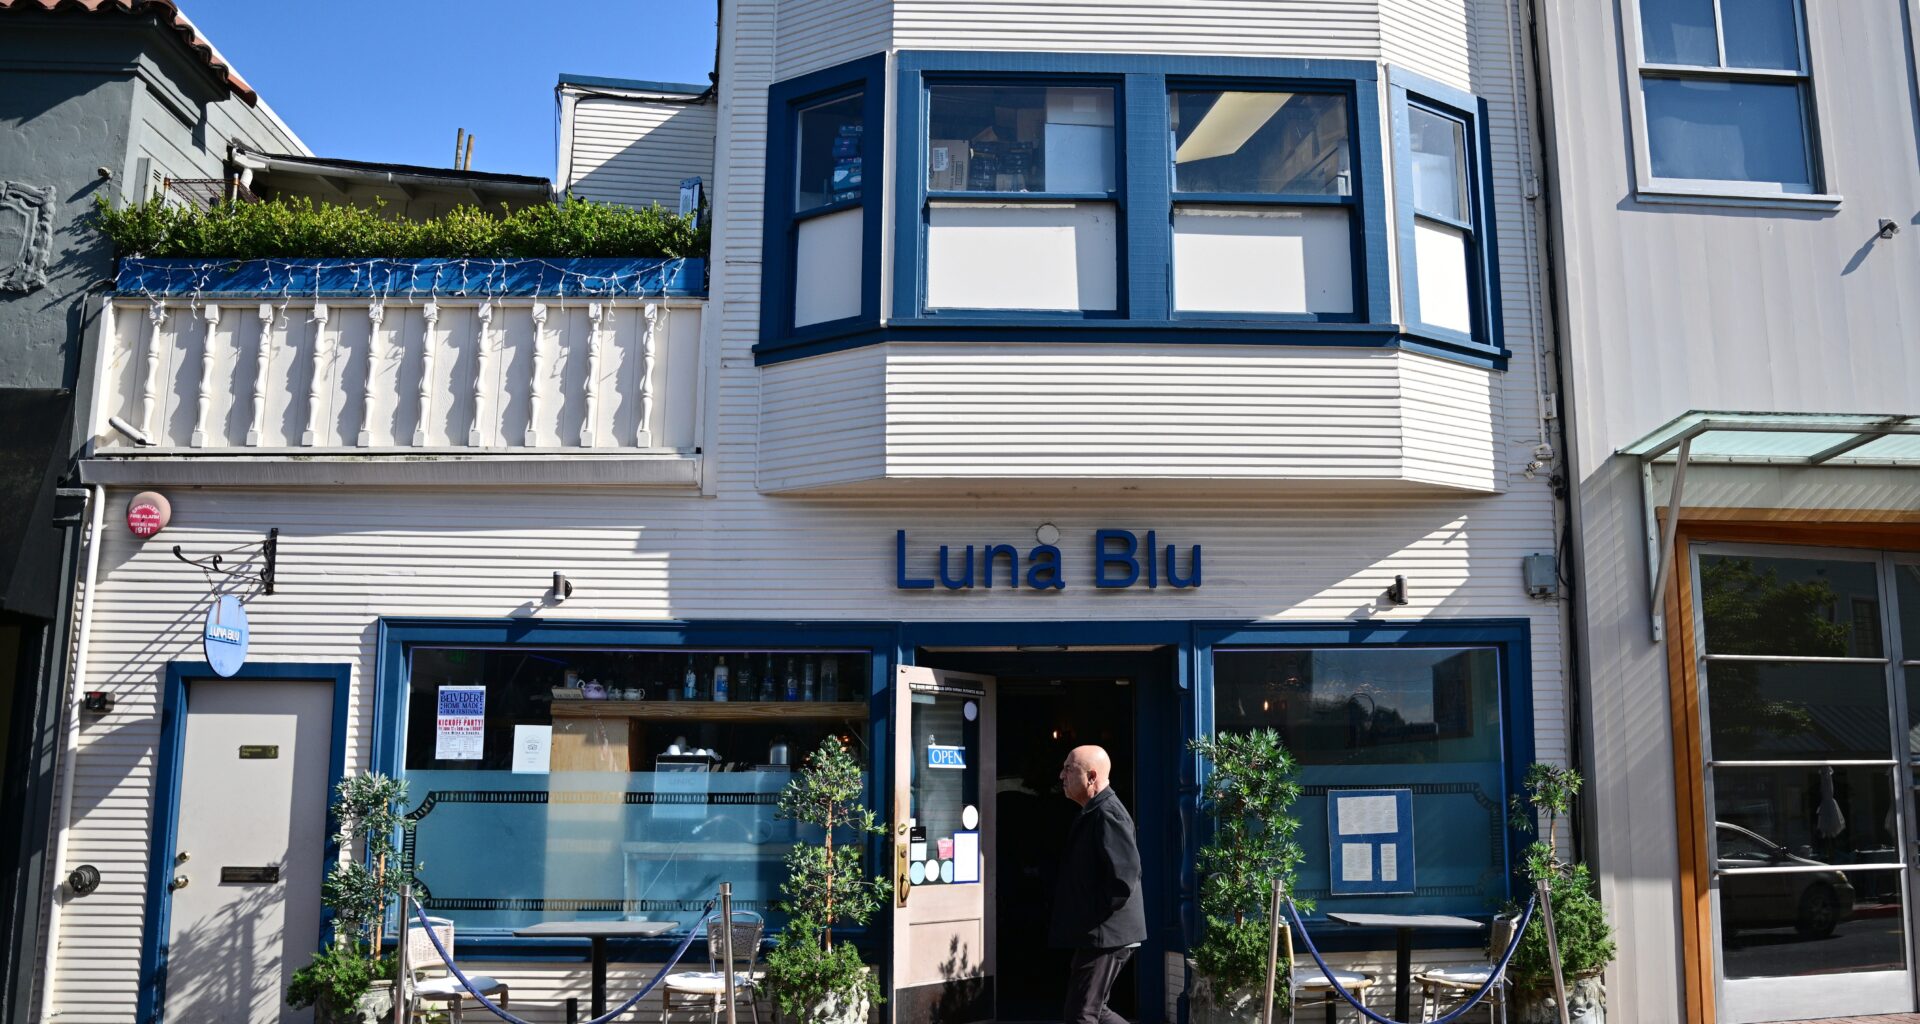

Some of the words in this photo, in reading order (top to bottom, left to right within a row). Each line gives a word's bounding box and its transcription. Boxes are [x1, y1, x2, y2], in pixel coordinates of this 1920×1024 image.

[897, 529, 1065, 590] Luna
[1095, 529, 1202, 589] Blu
[440, 692, 484, 703] BELVEDERE
[931, 749, 963, 765] OPEN
